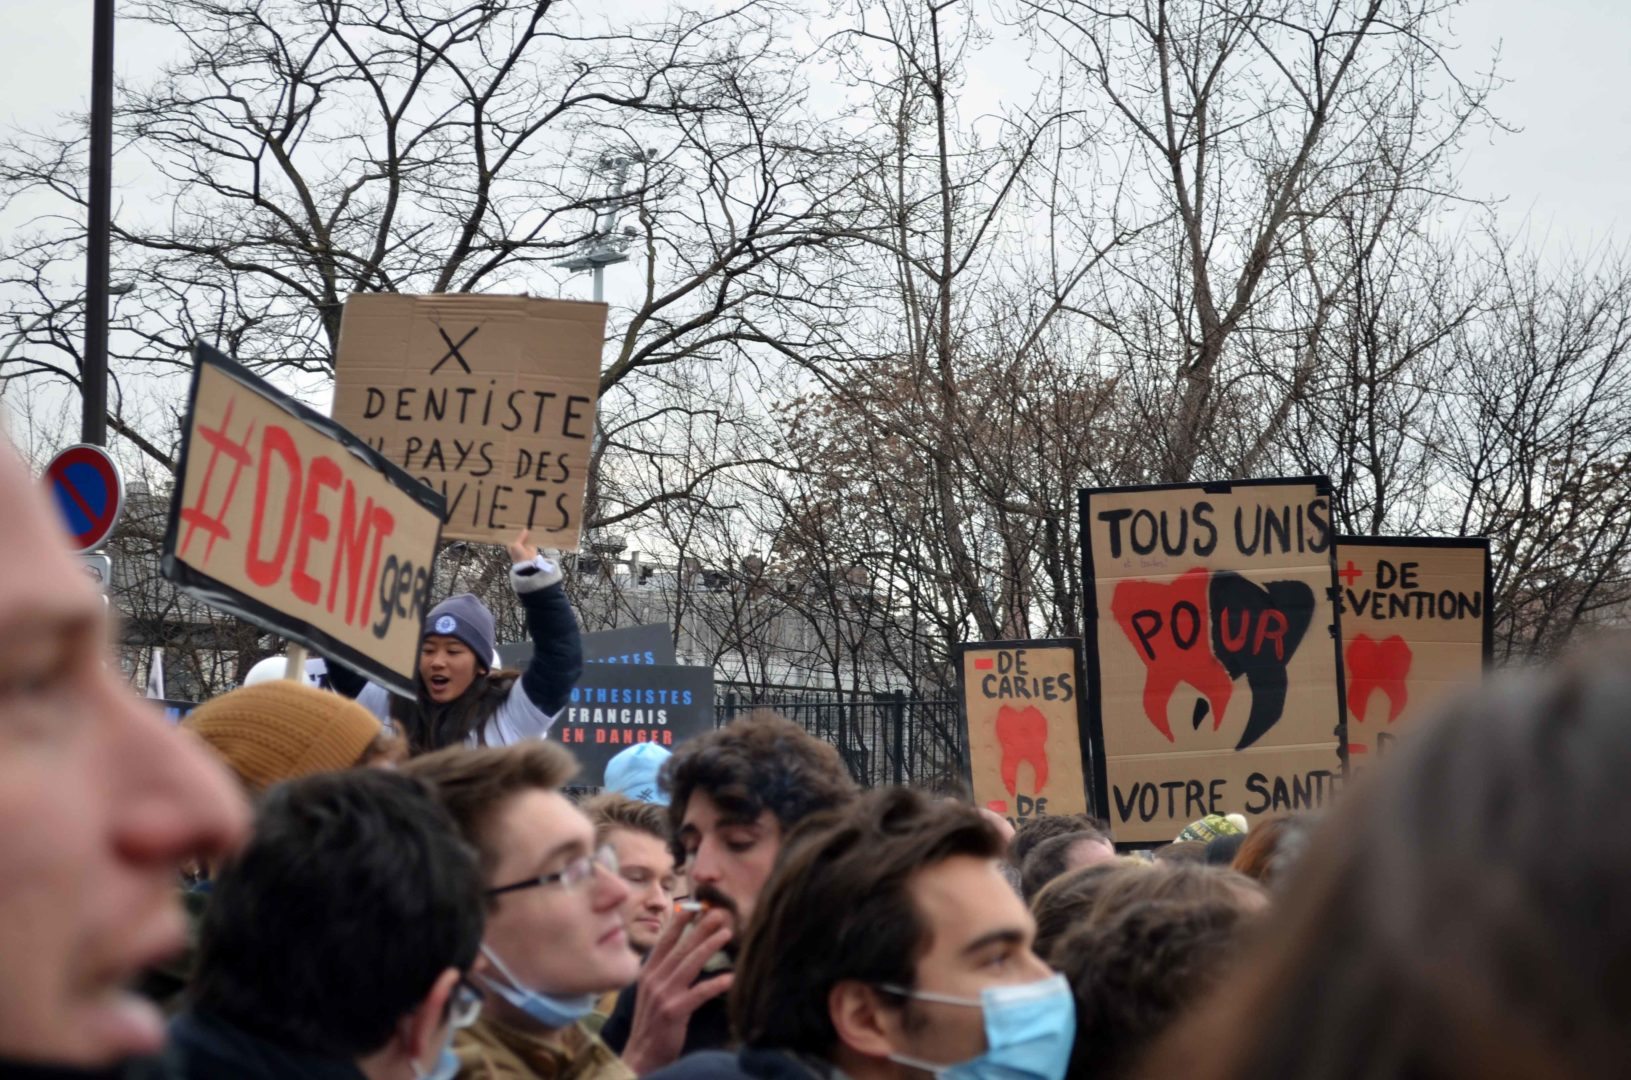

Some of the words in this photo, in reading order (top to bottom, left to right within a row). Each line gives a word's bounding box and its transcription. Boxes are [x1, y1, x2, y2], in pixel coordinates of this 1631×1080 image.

[403, 436, 494, 477] PAYS
[513, 448, 571, 484] DES
[1097, 501, 1219, 559] TOUS
[1234, 499, 1332, 557] UNIS
[1376, 560, 1419, 590] DE
[1131, 600, 1290, 661] POUR
[997, 650, 1029, 676] DE
[982, 673, 1074, 702] CARIES
[568, 707, 668, 725] FRANCAIS
[562, 727, 585, 743] EN
[596, 728, 672, 745] DANGER
[1016, 794, 1048, 817] DE
[1113, 779, 1228, 823] VOTRE
